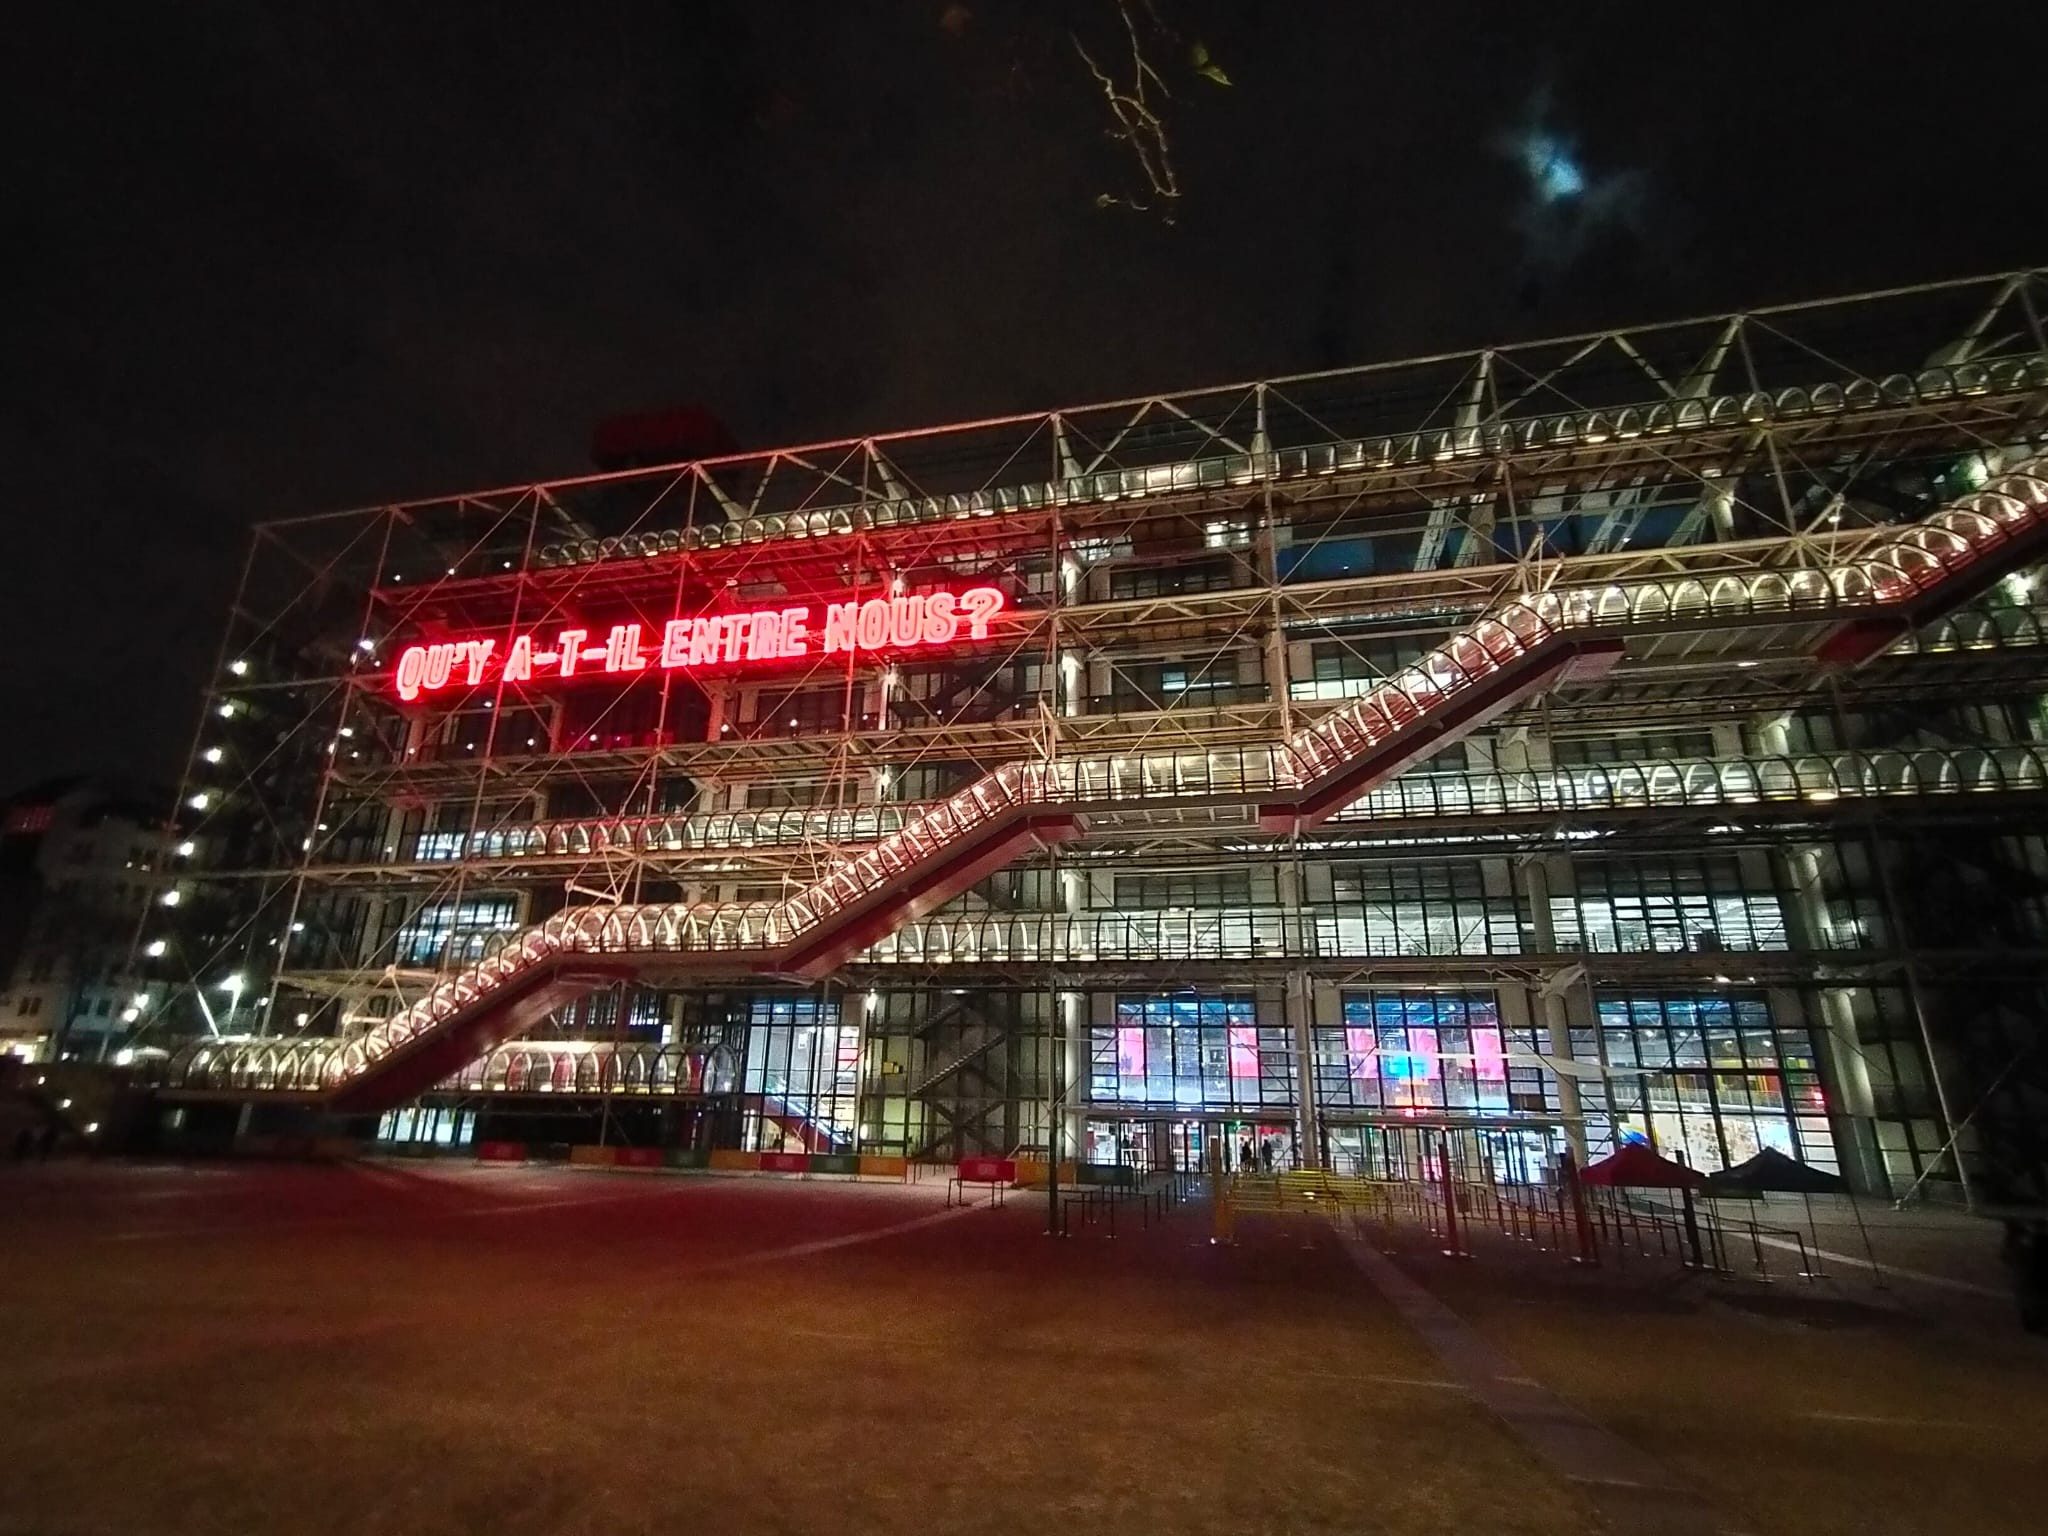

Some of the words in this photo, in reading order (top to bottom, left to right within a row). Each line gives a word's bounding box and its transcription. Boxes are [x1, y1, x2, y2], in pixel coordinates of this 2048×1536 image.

[397, 639, 495, 700] QU'Y
[503, 624, 646, 681] A-T-IL
[661, 607, 809, 668] ENTRE
[824, 587, 1004, 653] NOUS?
